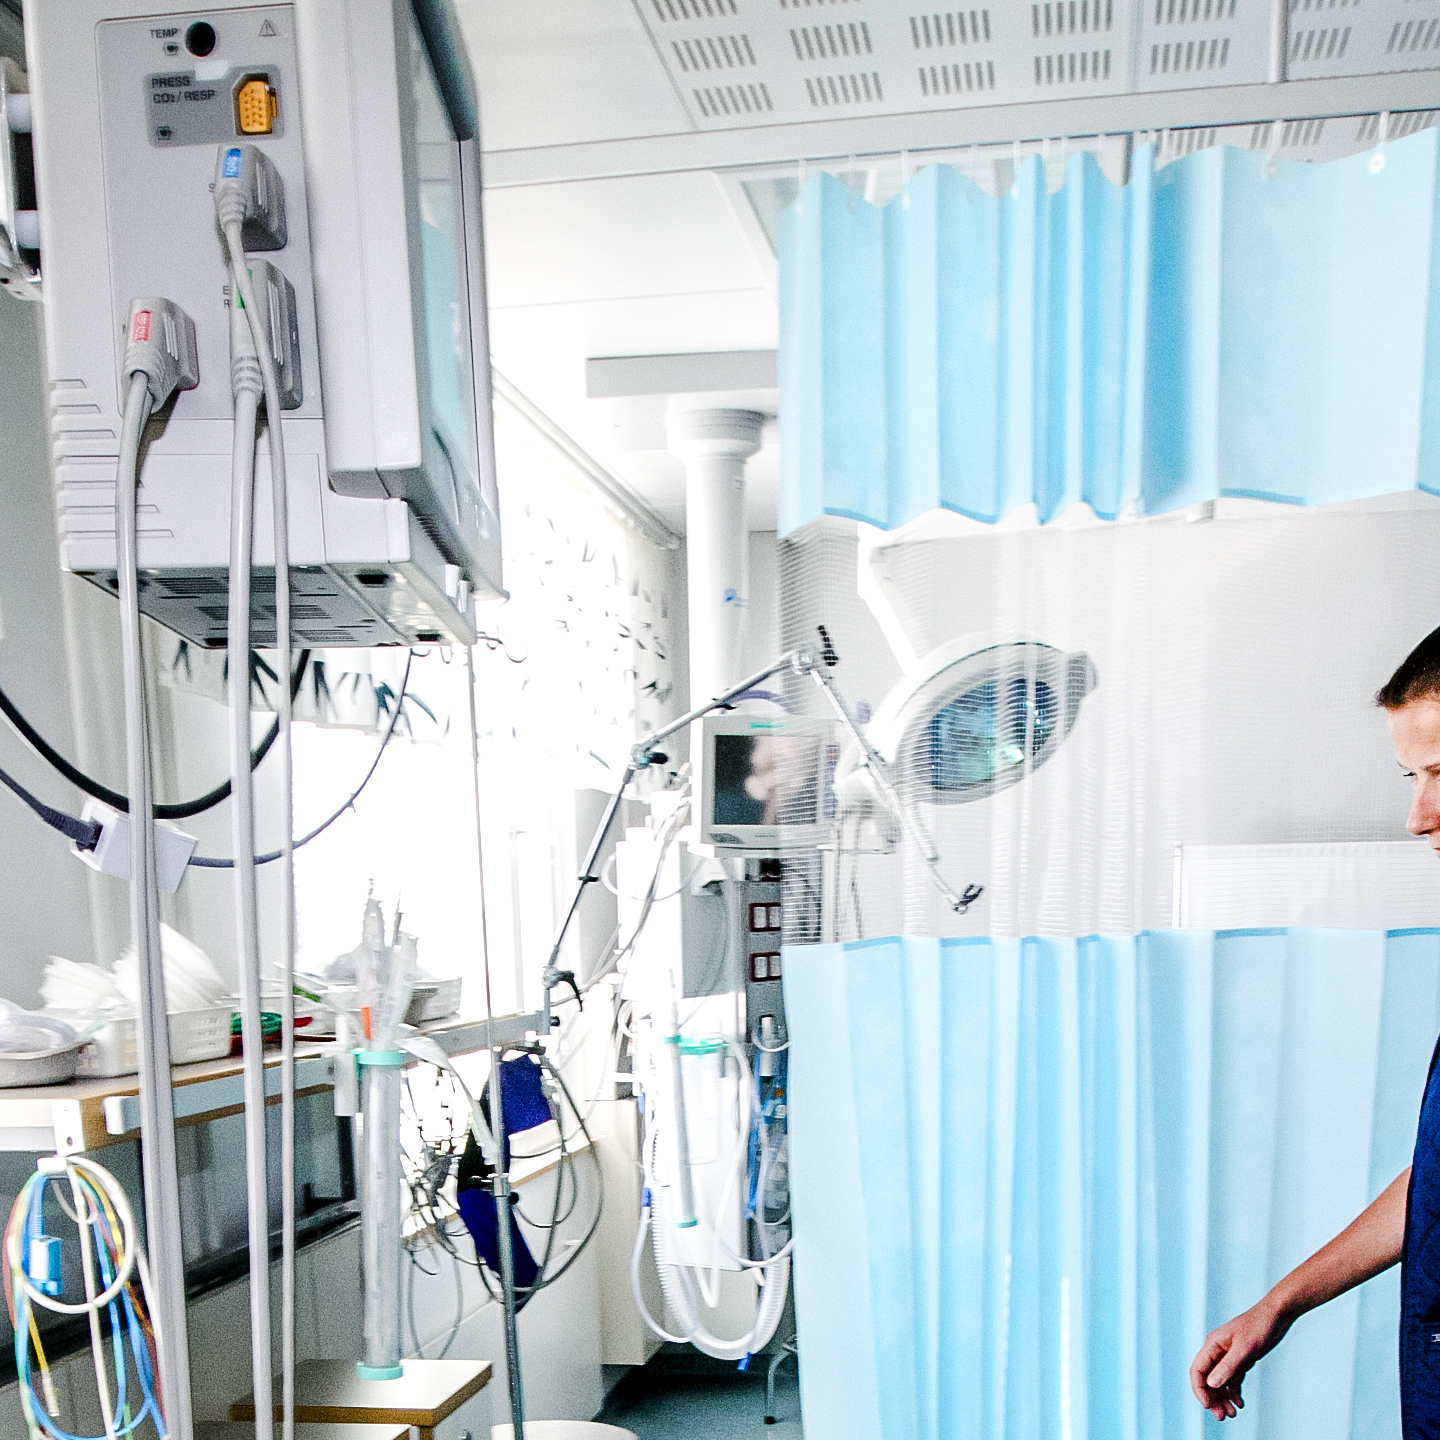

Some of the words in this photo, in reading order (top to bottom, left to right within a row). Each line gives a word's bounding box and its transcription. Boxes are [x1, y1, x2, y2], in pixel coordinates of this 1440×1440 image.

[150, 28, 178, 38] TEMP
[151, 76, 190, 88] PRESS
[184, 89, 216, 101] RESP
